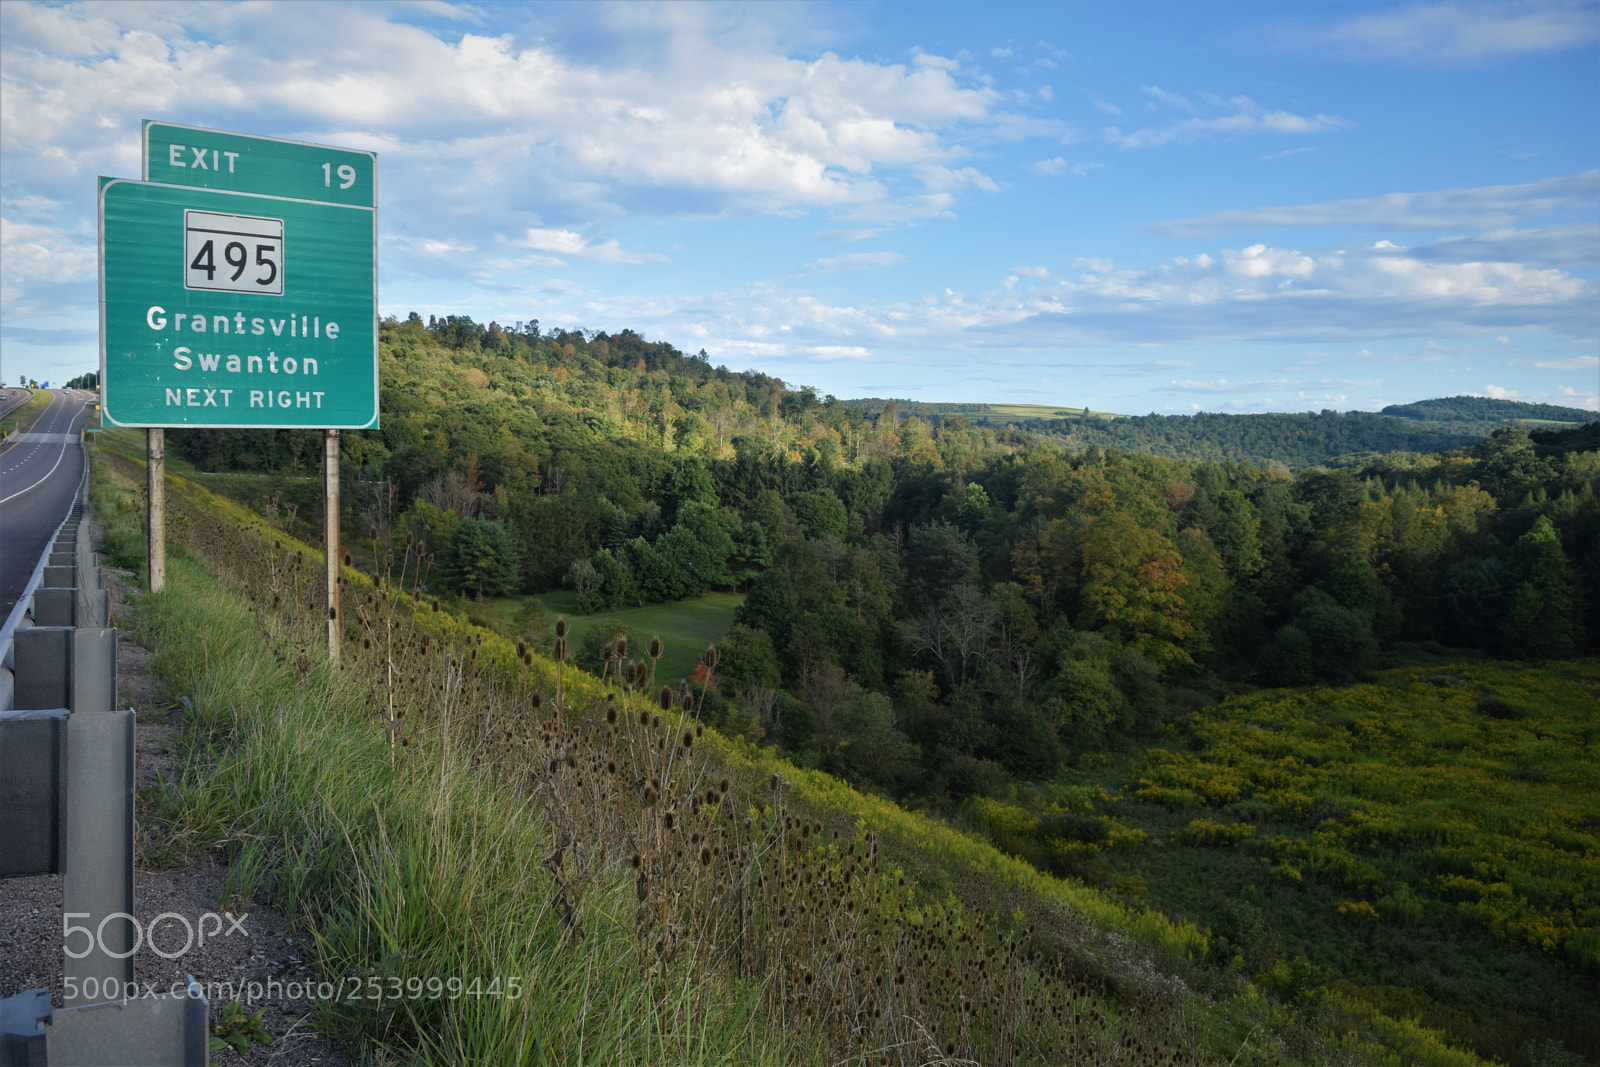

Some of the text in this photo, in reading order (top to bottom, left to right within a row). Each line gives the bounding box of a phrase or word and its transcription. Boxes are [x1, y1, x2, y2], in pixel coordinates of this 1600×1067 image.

[169, 144, 356, 189] EXIT 19
[190, 239, 277, 286] 495
[146, 305, 340, 339] Grantsville
[173, 346, 318, 375] Swanton
[165, 388, 325, 409] NEXT RIGHT
